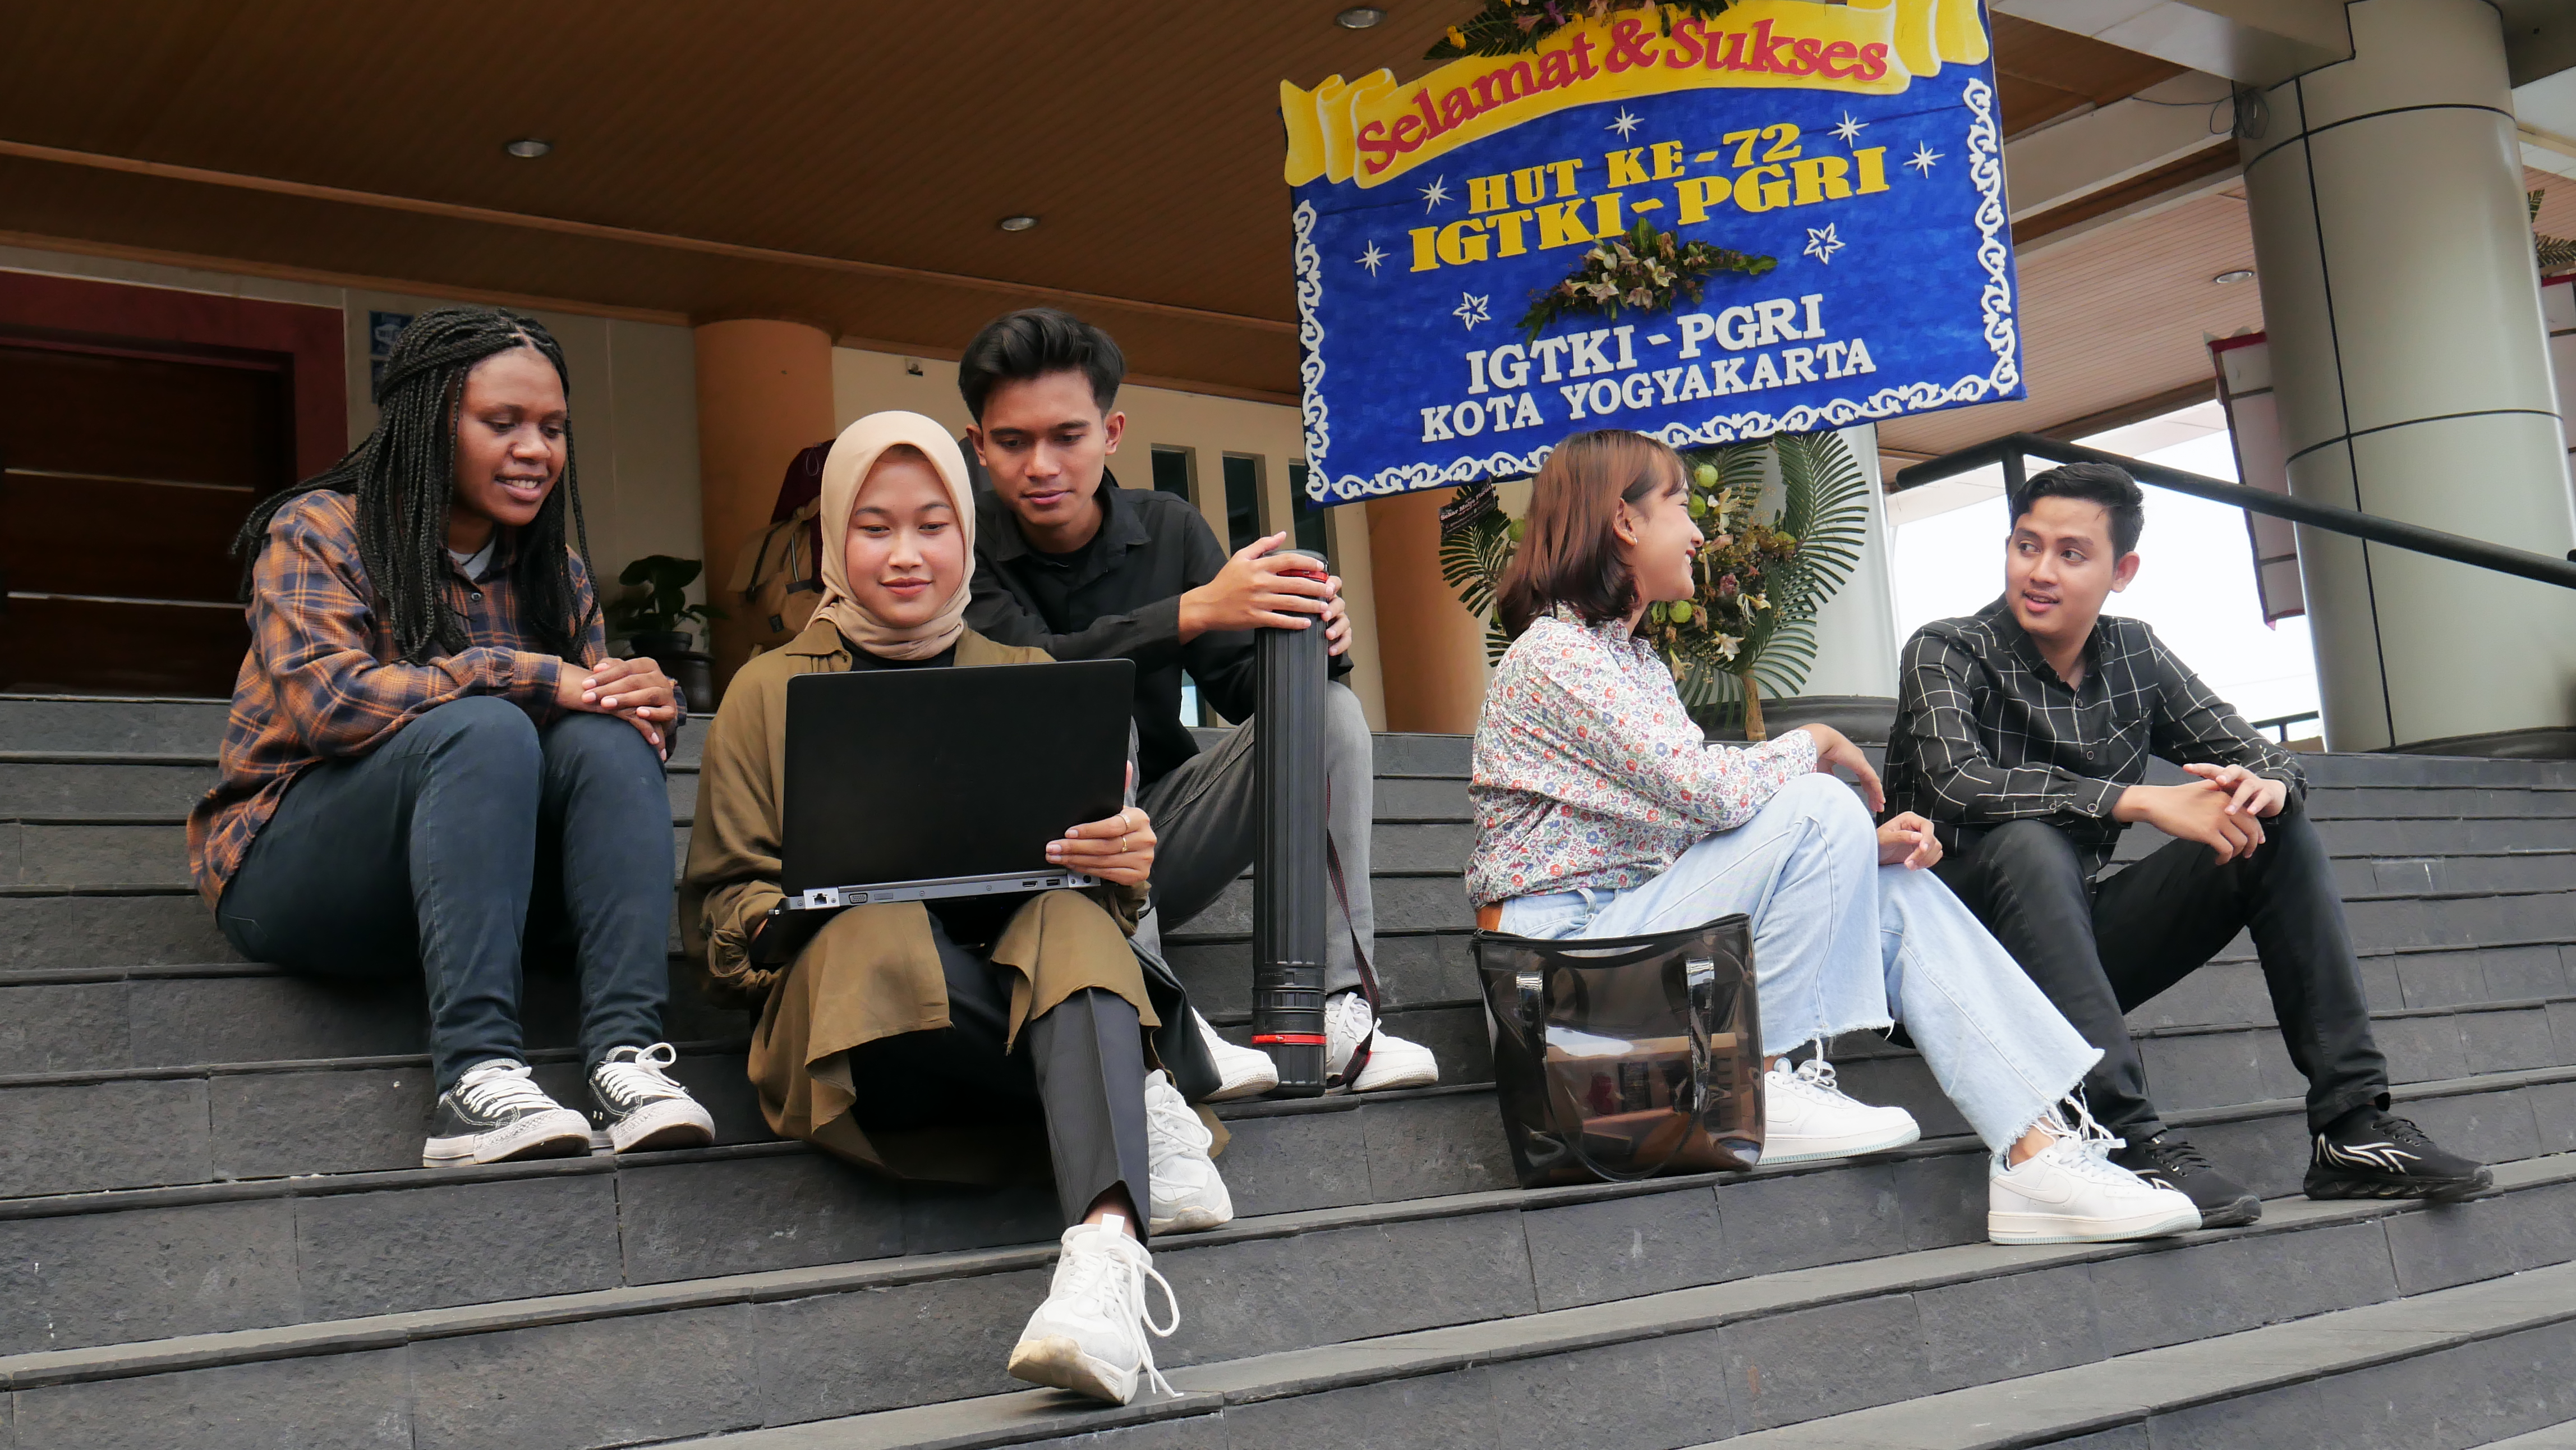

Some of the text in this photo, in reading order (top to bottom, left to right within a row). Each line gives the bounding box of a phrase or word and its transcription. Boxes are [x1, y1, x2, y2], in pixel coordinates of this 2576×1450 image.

[1357, 16, 1888, 175] Selamat & Sukses
[1466, 158, 1583, 214] HUT
[1420, 338, 1876, 443] KOTA YOGYAKARTA
